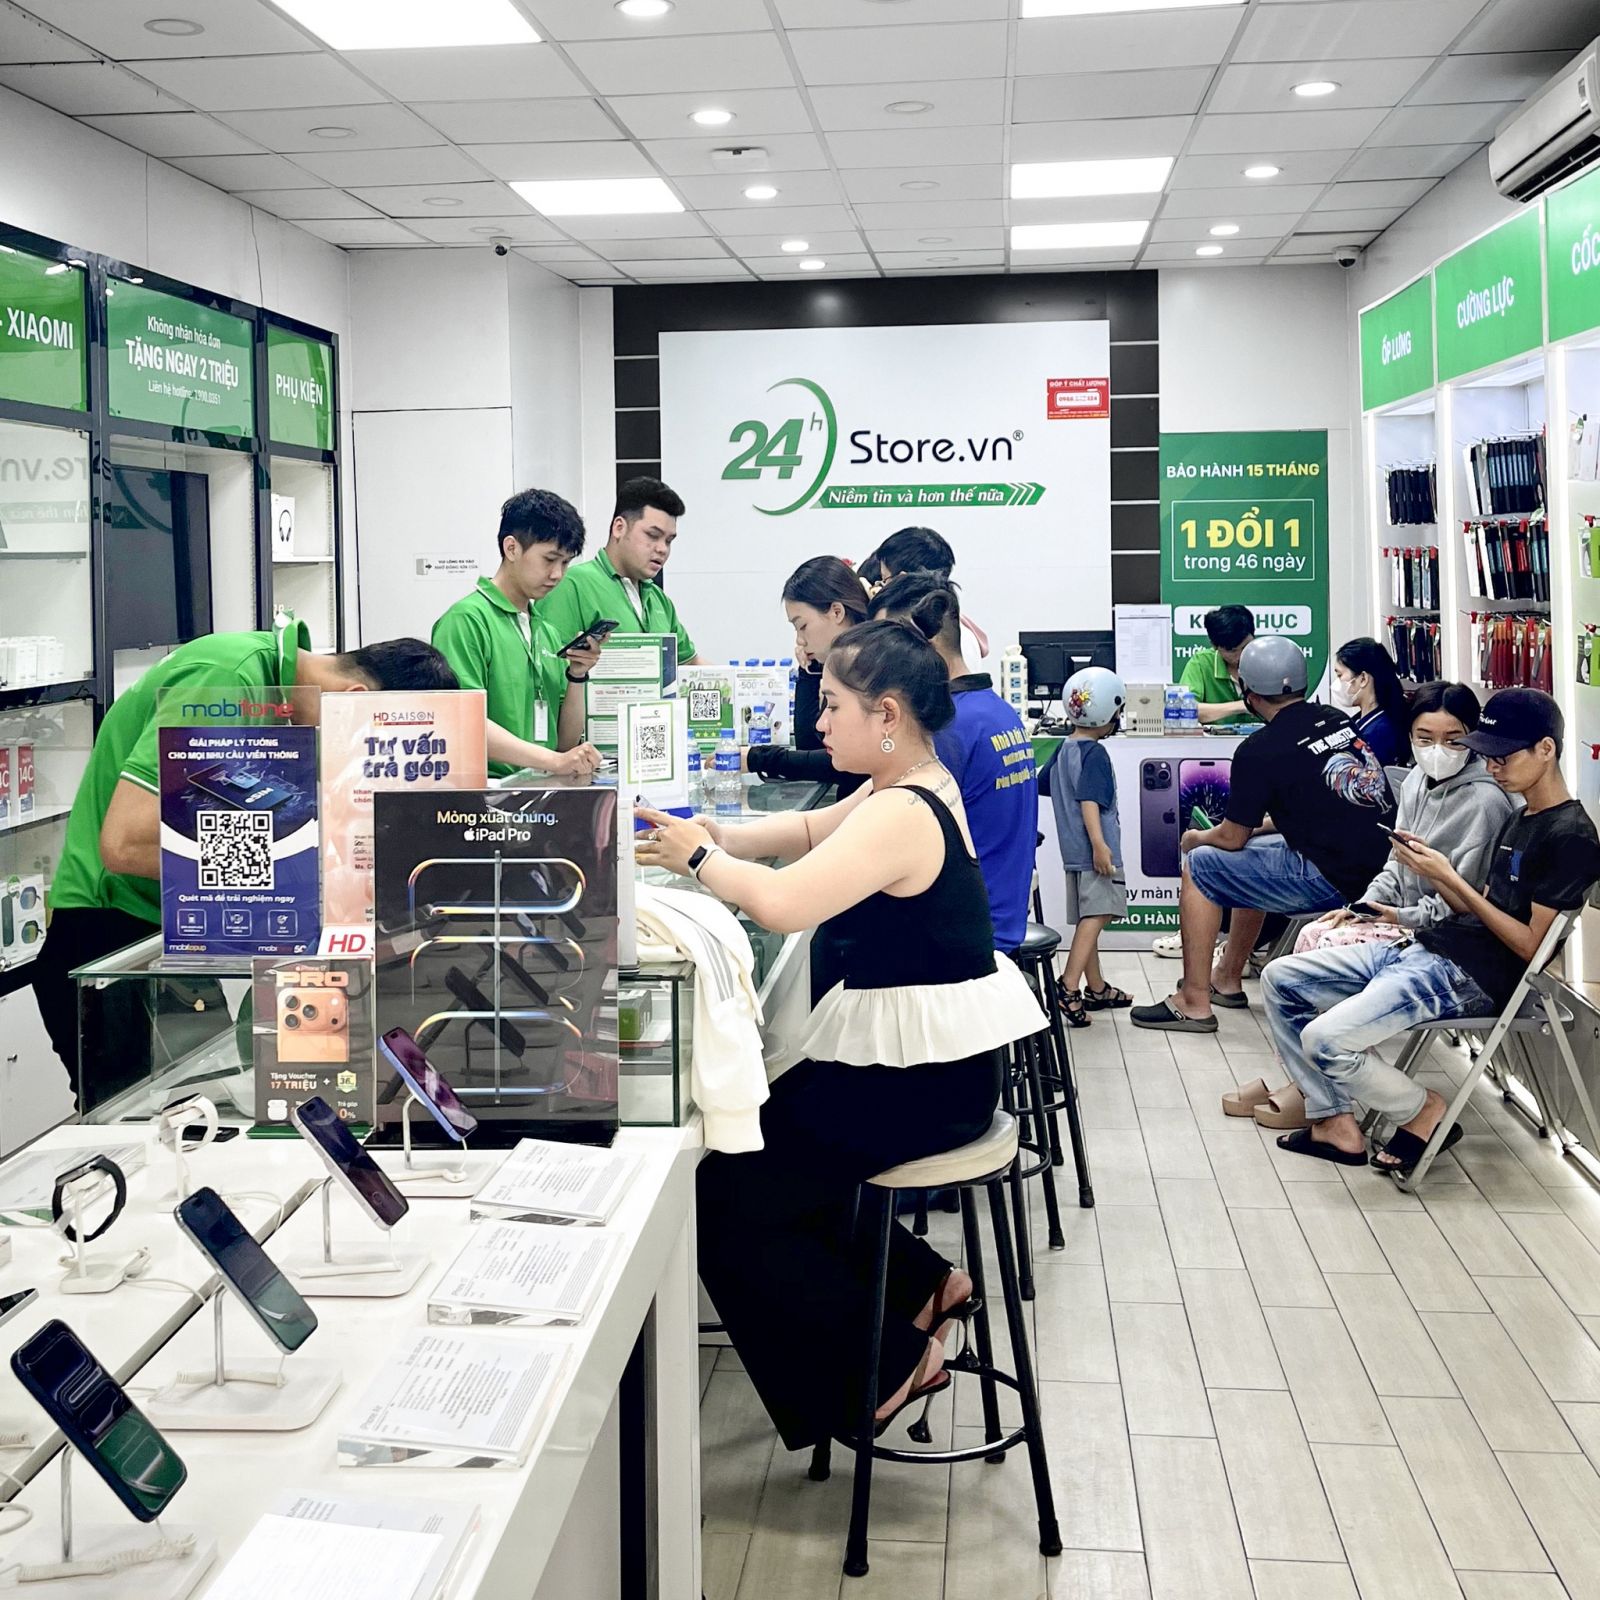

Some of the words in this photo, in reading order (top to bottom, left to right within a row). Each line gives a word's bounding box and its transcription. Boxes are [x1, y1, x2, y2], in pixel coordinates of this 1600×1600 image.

[1457, 289, 1491, 328] CƯỜNG
[1492, 275, 1515, 317] LỰC
[7, 306, 73, 350] XIAOMI
[147, 315, 174, 340] Không
[175, 323, 193, 343] nhận
[125, 336, 163, 371] TẶNG
[165, 349, 198, 378] NGAY
[200, 358, 207, 380] 2
[208, 359, 239, 391] TRIỆU
[276, 374, 297, 405] PHỤ
[300, 377, 323, 408] KIỆN
[1167, 462, 1197, 478] BẢO
[1200, 462, 1244, 477] HÀNH
[1247, 464, 1263, 476] 15
[1266, 461, 1320, 476] THÁNG
[829, 487, 868, 503] Niềm
[873, 490, 892, 503] tin
[898, 489, 913, 503] và
[918, 489, 944, 502] hơn
[950, 486, 977, 501] thế
[978, 488, 1005, 501] nữa
[1181, 520, 1196, 548] 1
[1206, 506, 1274, 548] ĐỔI
[1284, 518, 1299, 547] 1
[1184, 555, 1231, 572] trong
[1235, 554, 1258, 569] 46
[1263, 553, 1306, 572] ngày
[1256, 613, 1298, 632] HỤC
[182, 698, 294, 717] mobifone
[373, 712, 389, 721] HD
[391, 711, 434, 721] SAISON
[208, 737, 233, 747] PHÁP
[364, 737, 397, 756] Tư
[402, 731, 446, 755] vấn
[168, 752, 187, 760] CHO
[188, 751, 205, 761] MỌI
[206, 752, 225, 760] NHU
[226, 749, 245, 760] CẦU
[269, 750, 299, 760] THÔNG
[363, 756, 398, 778] trả
[404, 755, 450, 782] góp
[475, 828, 506, 841] iPad
[508, 828, 531, 841] Pro
[179, 894, 199, 903] Quét
[200, 894, 213, 902] mã
[215, 893, 225, 902] để
[242, 895, 274, 904] nghiệm
[275, 896, 295, 904] ngay
[1142, 887, 1173, 899] màn
[1145, 911, 1180, 925] HÀN
[328, 934, 367, 953] HD
[276, 971, 349, 987] PRO
[270, 1072, 287, 1080] Tặng
[289, 1072, 317, 1080] Voucher
[271, 1081, 281, 1089] 17
[284, 1079, 317, 1091] TRIỆU
[339, 1108, 356, 1119] 0%
